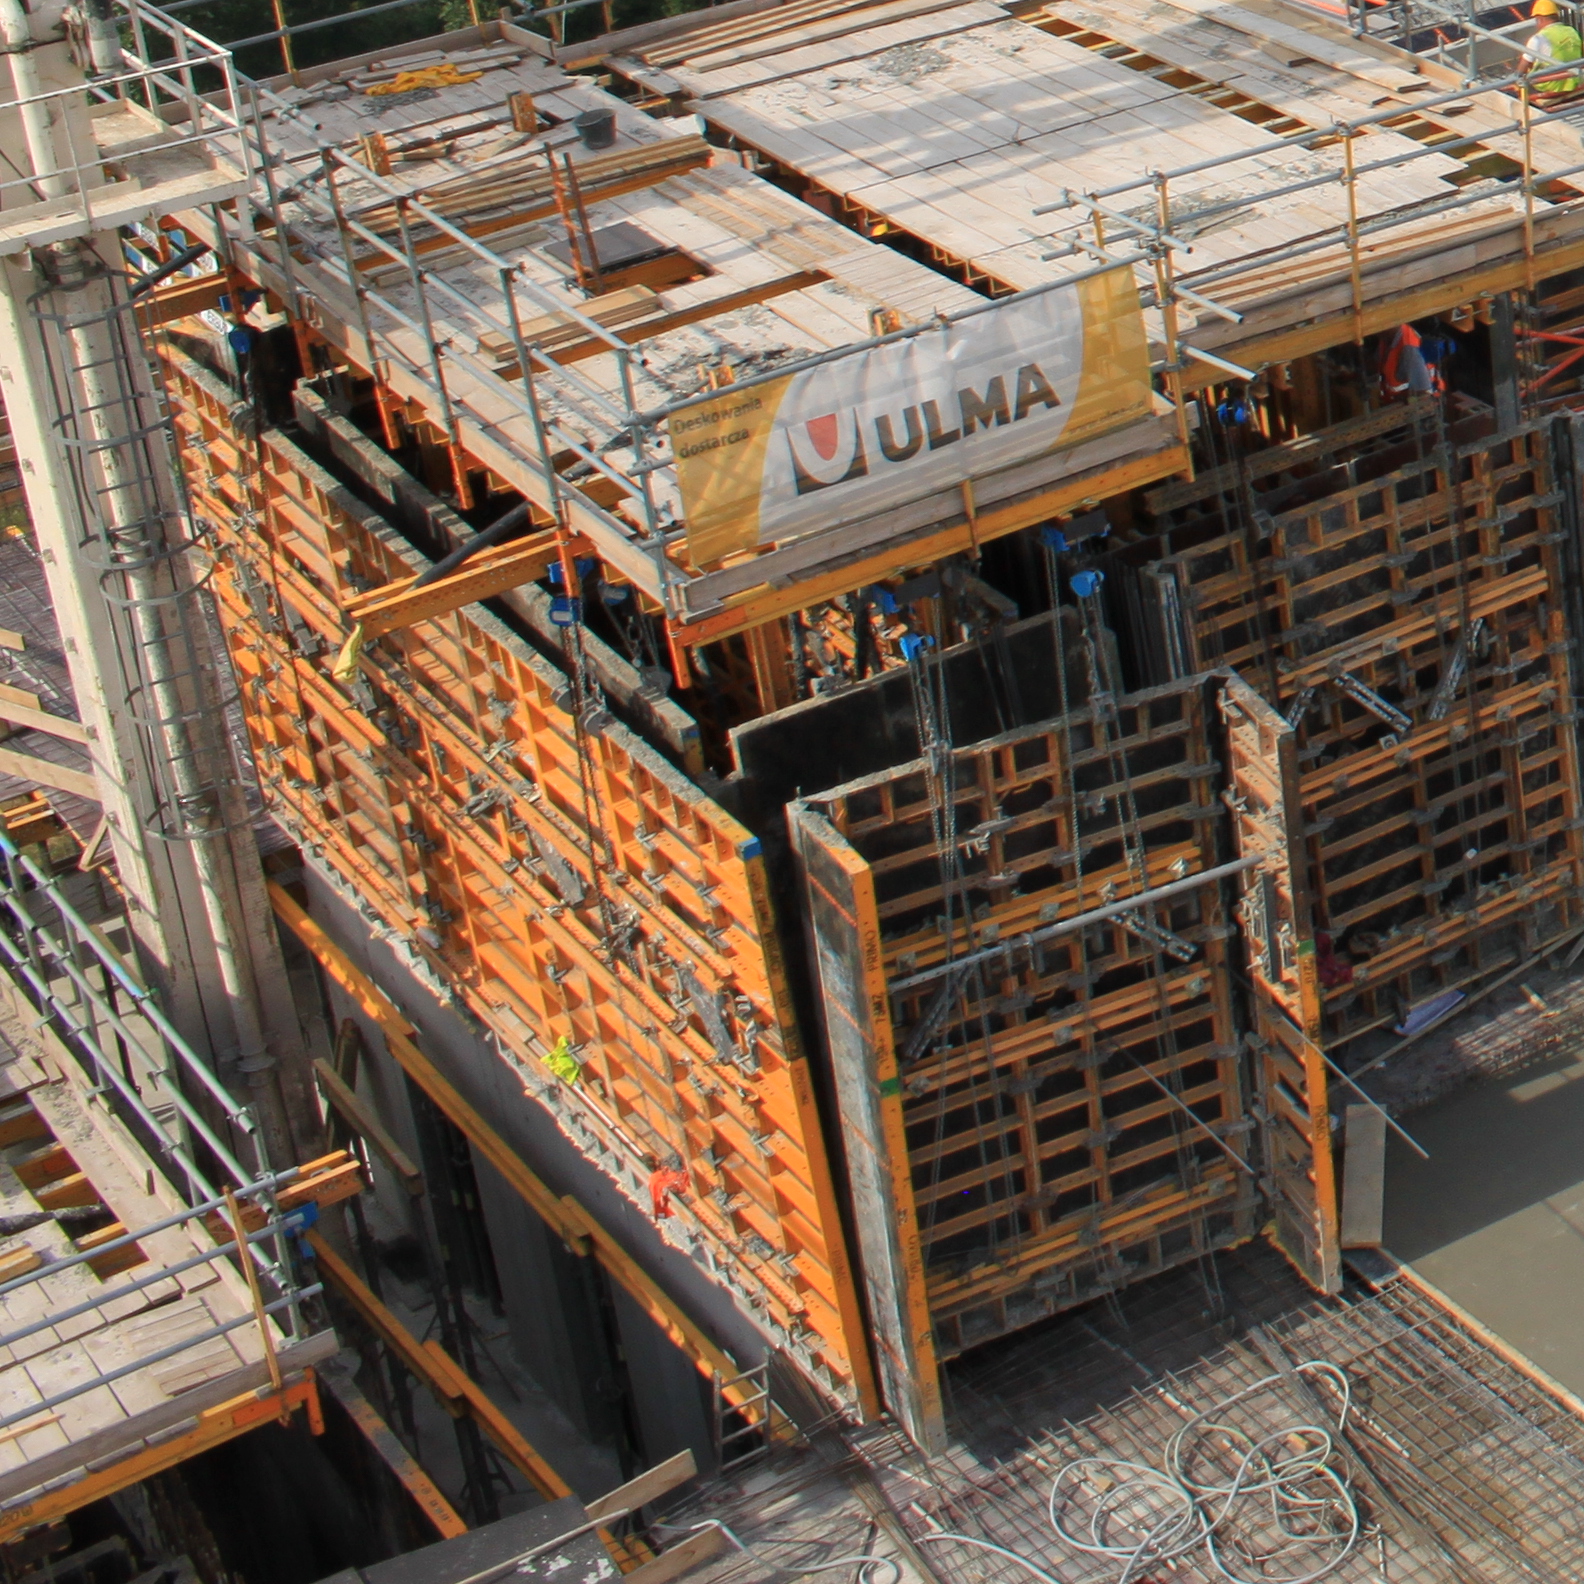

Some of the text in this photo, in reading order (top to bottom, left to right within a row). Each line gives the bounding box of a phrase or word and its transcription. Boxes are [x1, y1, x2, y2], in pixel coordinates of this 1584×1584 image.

[674, 398, 763, 434] Deskowania
[874, 363, 1062, 463] ULMA
[680, 428, 749, 458] dostarcza
